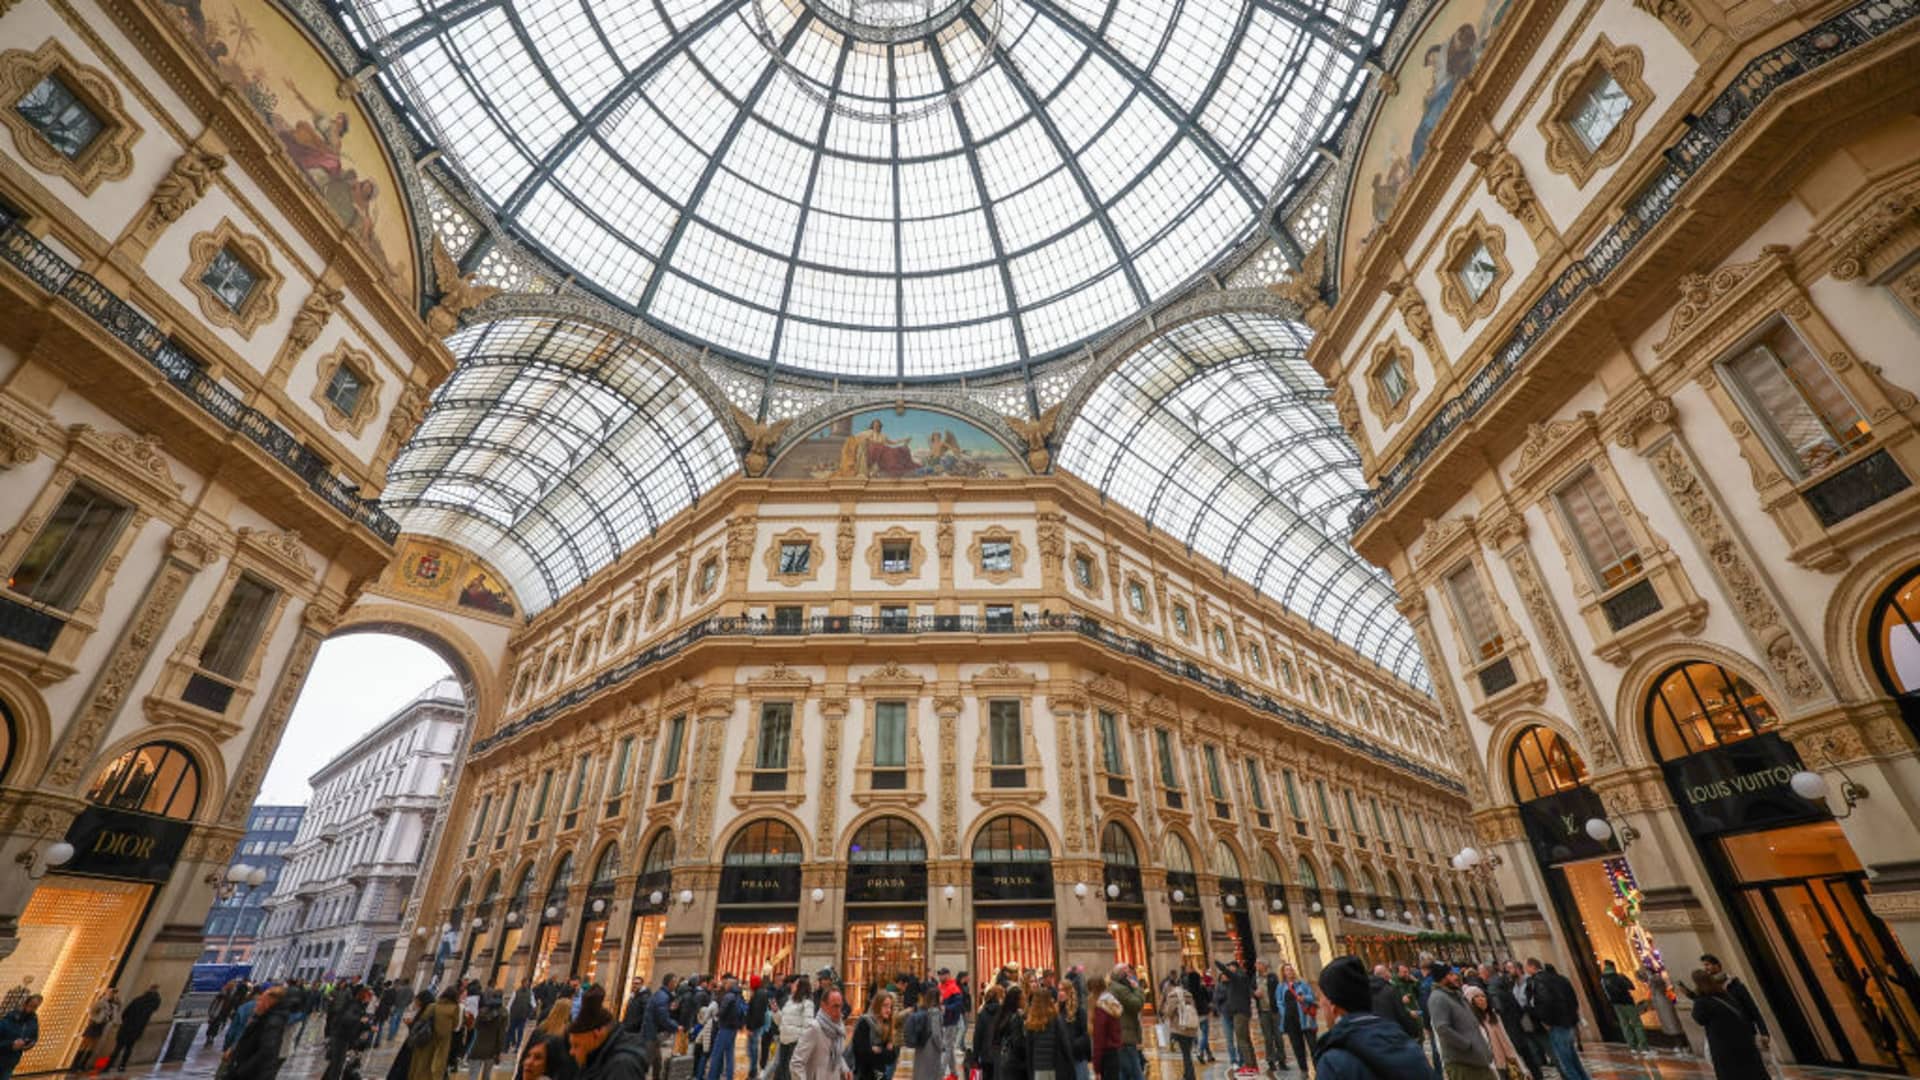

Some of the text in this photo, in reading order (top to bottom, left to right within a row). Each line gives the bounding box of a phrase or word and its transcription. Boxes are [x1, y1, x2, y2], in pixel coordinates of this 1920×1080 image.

[1686, 781, 1732, 804] LOUIS
[92, 831, 155, 858] DIOR
[741, 879, 780, 889] PRADA
[867, 878, 905, 888] PRADA
[992, 876, 1032, 887] PRADA
